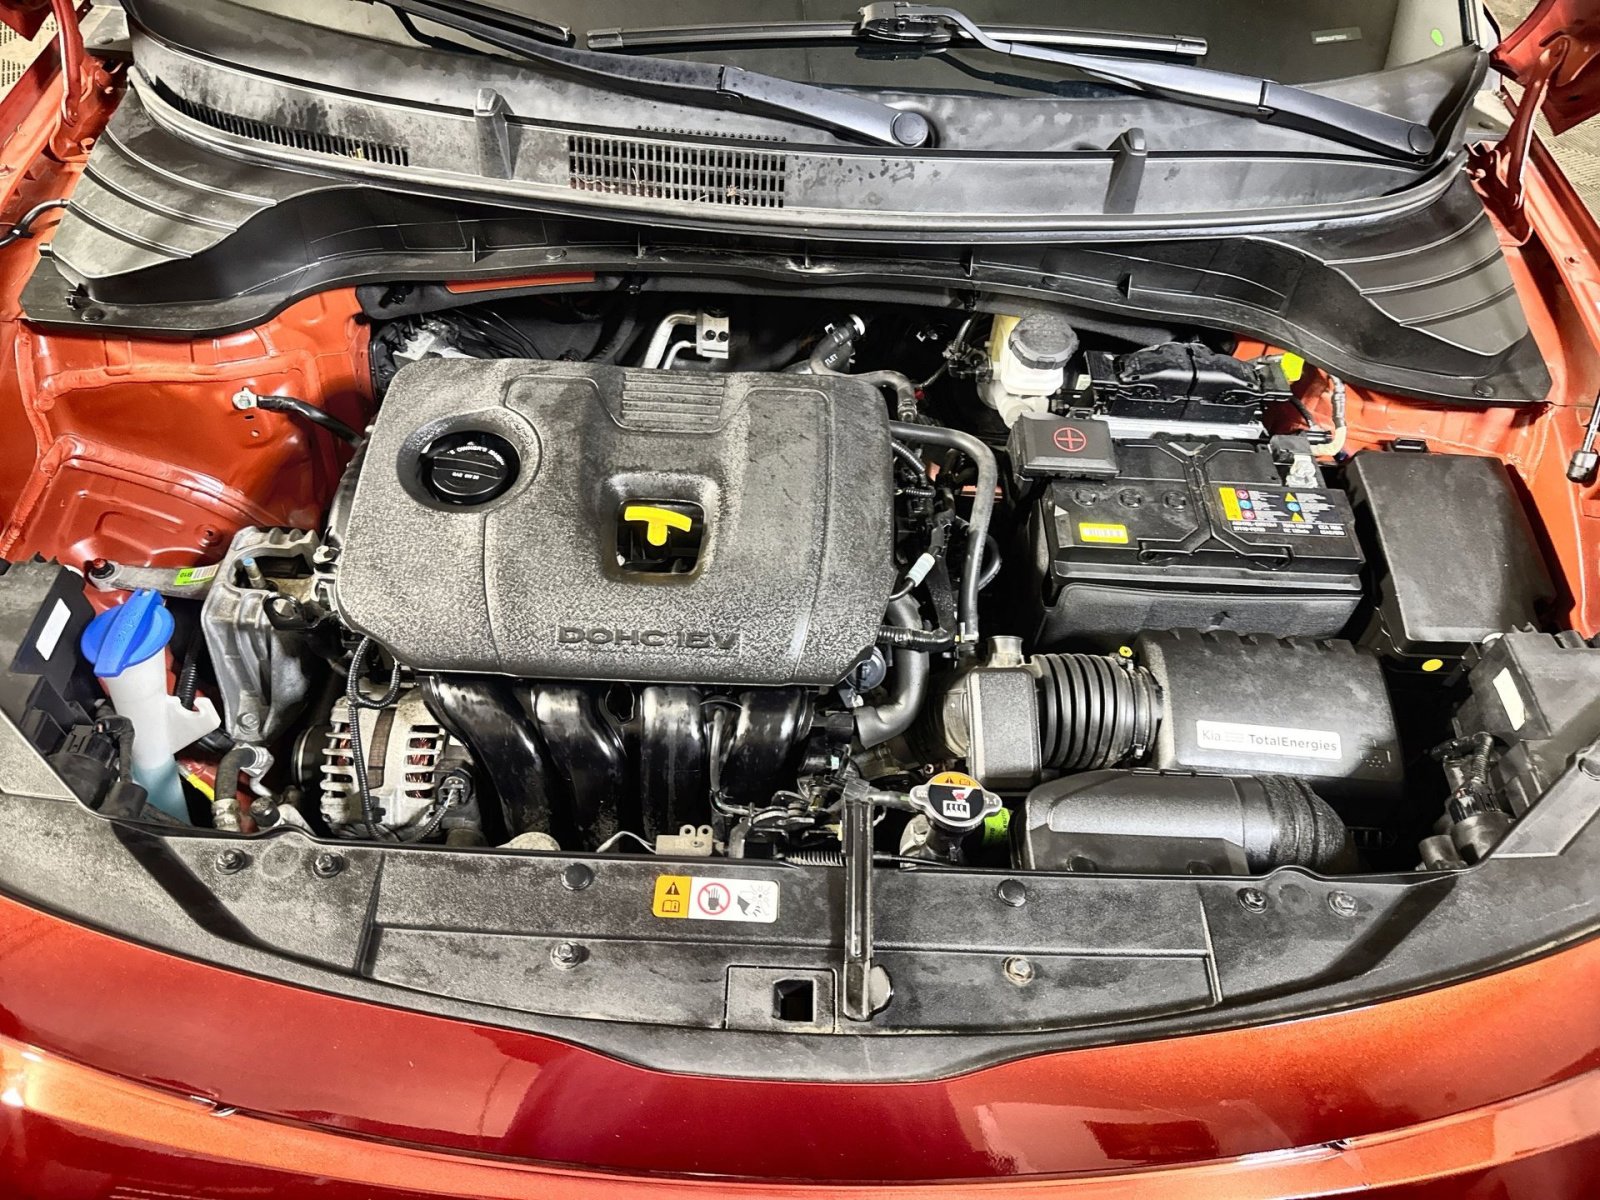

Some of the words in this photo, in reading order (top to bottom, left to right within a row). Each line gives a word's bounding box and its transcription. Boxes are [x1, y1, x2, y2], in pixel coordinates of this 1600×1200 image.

[557, 625, 667, 647] DOHC
[1201, 729, 1222, 743] Kia
[1248, 733, 1338, 752] TotalEnergies
